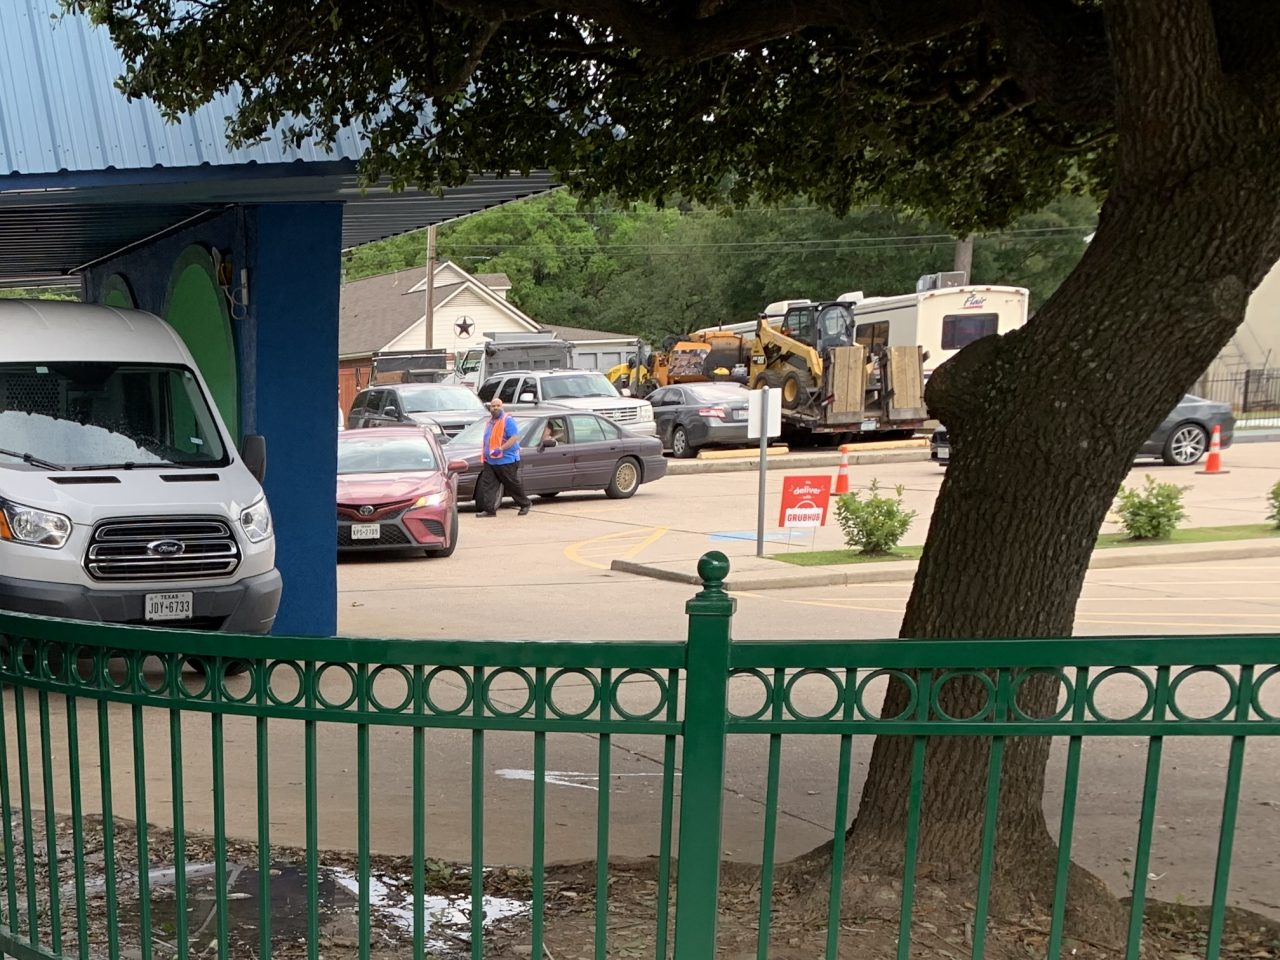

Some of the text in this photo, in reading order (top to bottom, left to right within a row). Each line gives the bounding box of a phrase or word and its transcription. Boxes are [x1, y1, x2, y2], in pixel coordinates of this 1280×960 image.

[964, 294, 987, 306] Flair
[793, 486, 822, 495] deliver
[787, 513, 820, 521] GRUBHUB
